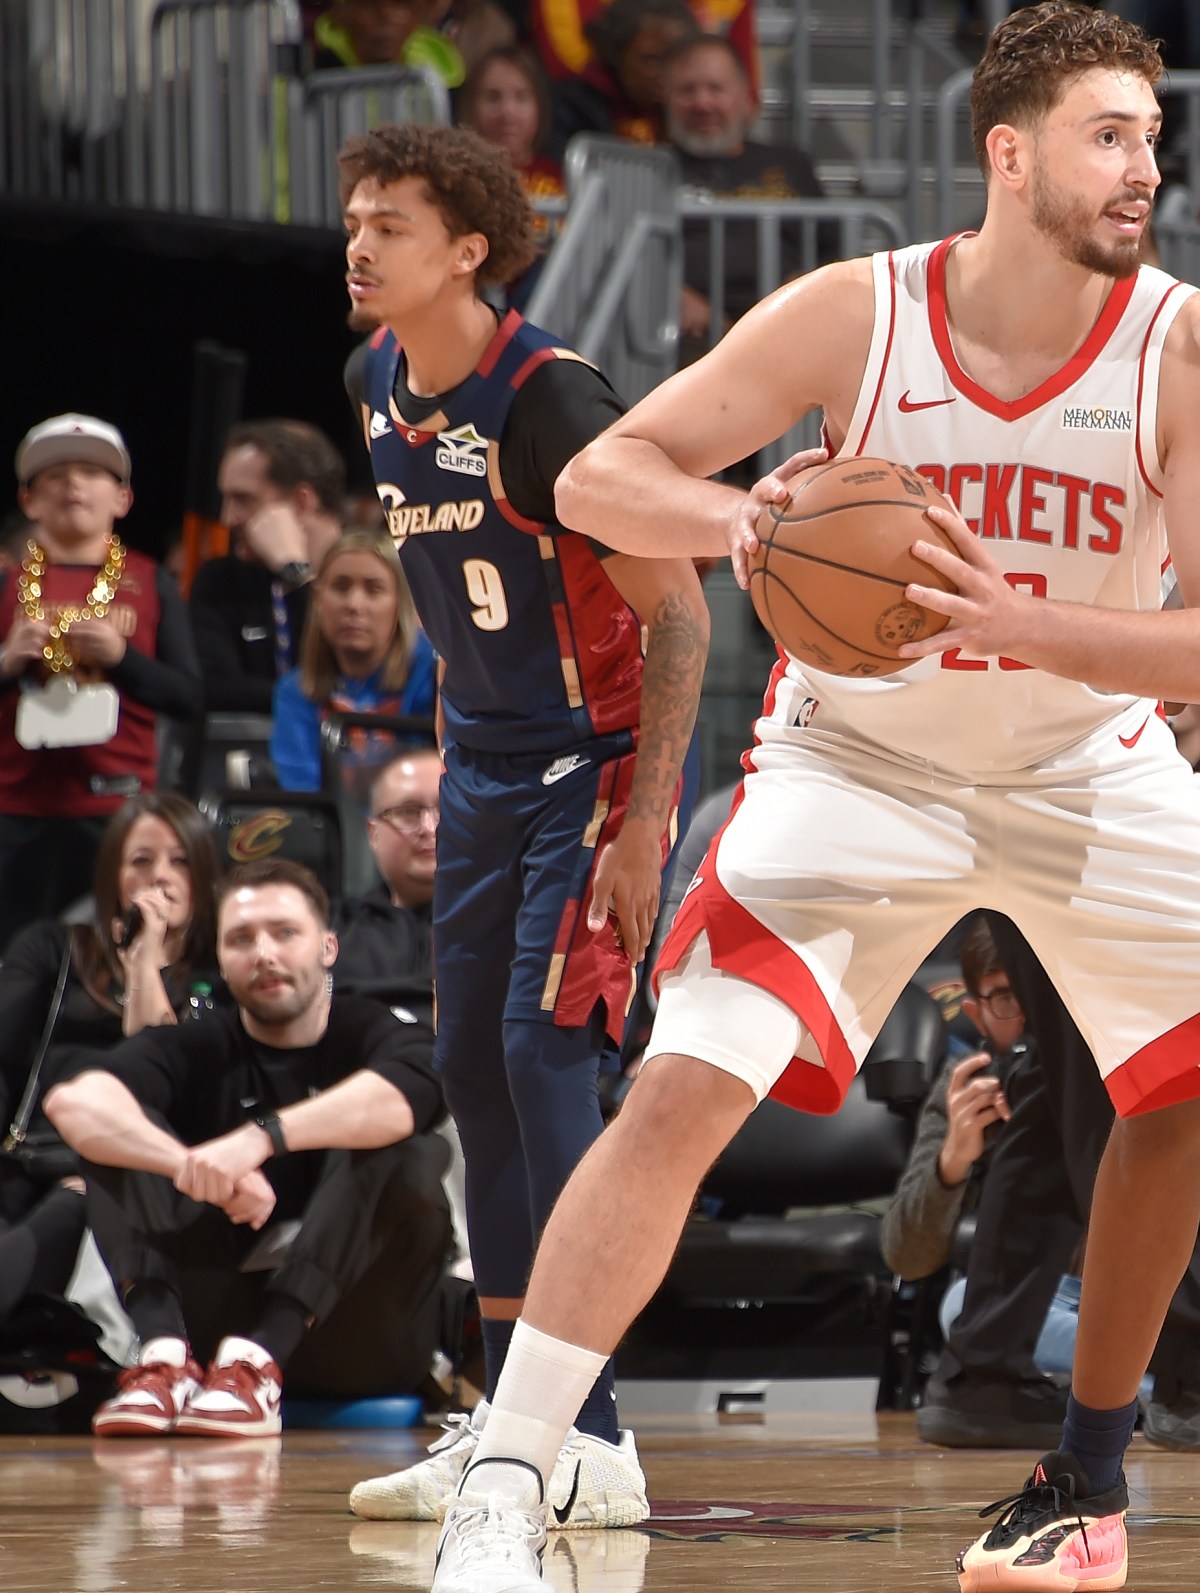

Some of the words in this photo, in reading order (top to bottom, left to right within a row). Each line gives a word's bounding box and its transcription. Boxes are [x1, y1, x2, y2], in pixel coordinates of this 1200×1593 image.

[1063, 408, 1133, 421] MEMORIAL
[1063, 416, 1132, 430] HERMANN
[438, 452, 486, 472] CLIFFS
[376, 482, 486, 551] CEVELAND
[914, 462, 1127, 555] CKETS
[462, 558, 510, 632] 9
